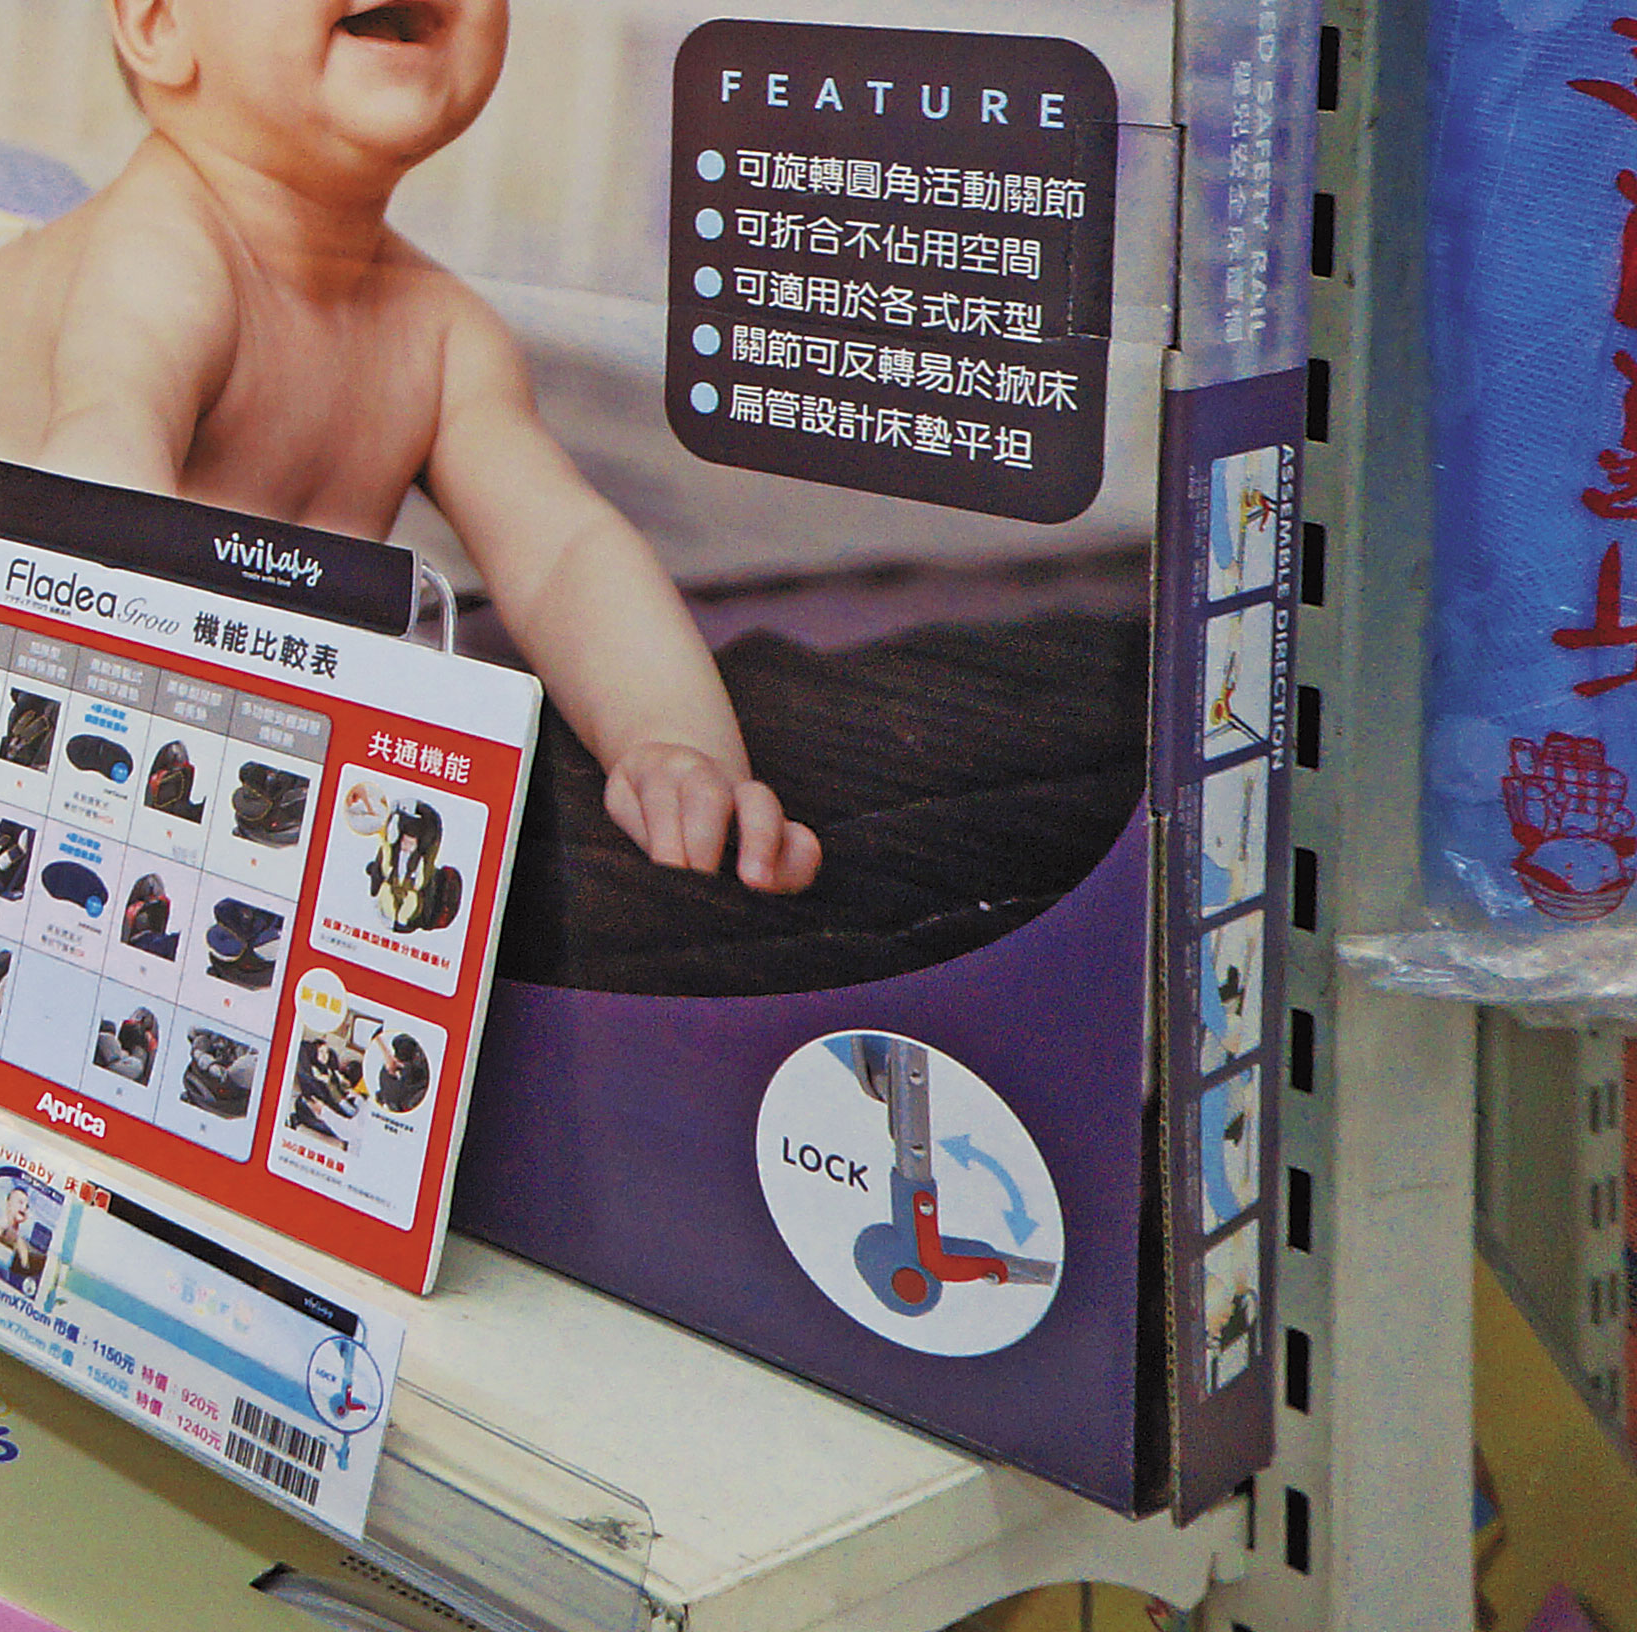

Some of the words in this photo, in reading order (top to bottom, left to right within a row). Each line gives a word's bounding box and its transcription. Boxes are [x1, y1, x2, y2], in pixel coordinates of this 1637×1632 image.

[720, 69, 1067, 130] FEATURE
[735, 148, 1087, 221] 可旋轉圓角活動關節
[734, 207, 1042, 282] 可折合不佔用空間
[733, 266, 1043, 344] 可適用於各式床型
[731, 324, 1080, 413] 關節可反轉易於掀床
[729, 383, 1034, 471] 扁管設計床墊平坦
[212, 530, 324, 588] vivibaby
[1276, 441, 1298, 604] ASSEMBLE
[4, 556, 118, 620] Fladea
[116, 596, 181, 637] Grow
[191, 610, 341, 680] 機能比較表
[1270, 609, 1291, 772] DIRECTION
[366, 728, 472, 784] 共通機能
[35, 1090, 107, 1139] Aprica
[782, 1135, 870, 1193] LOCK
